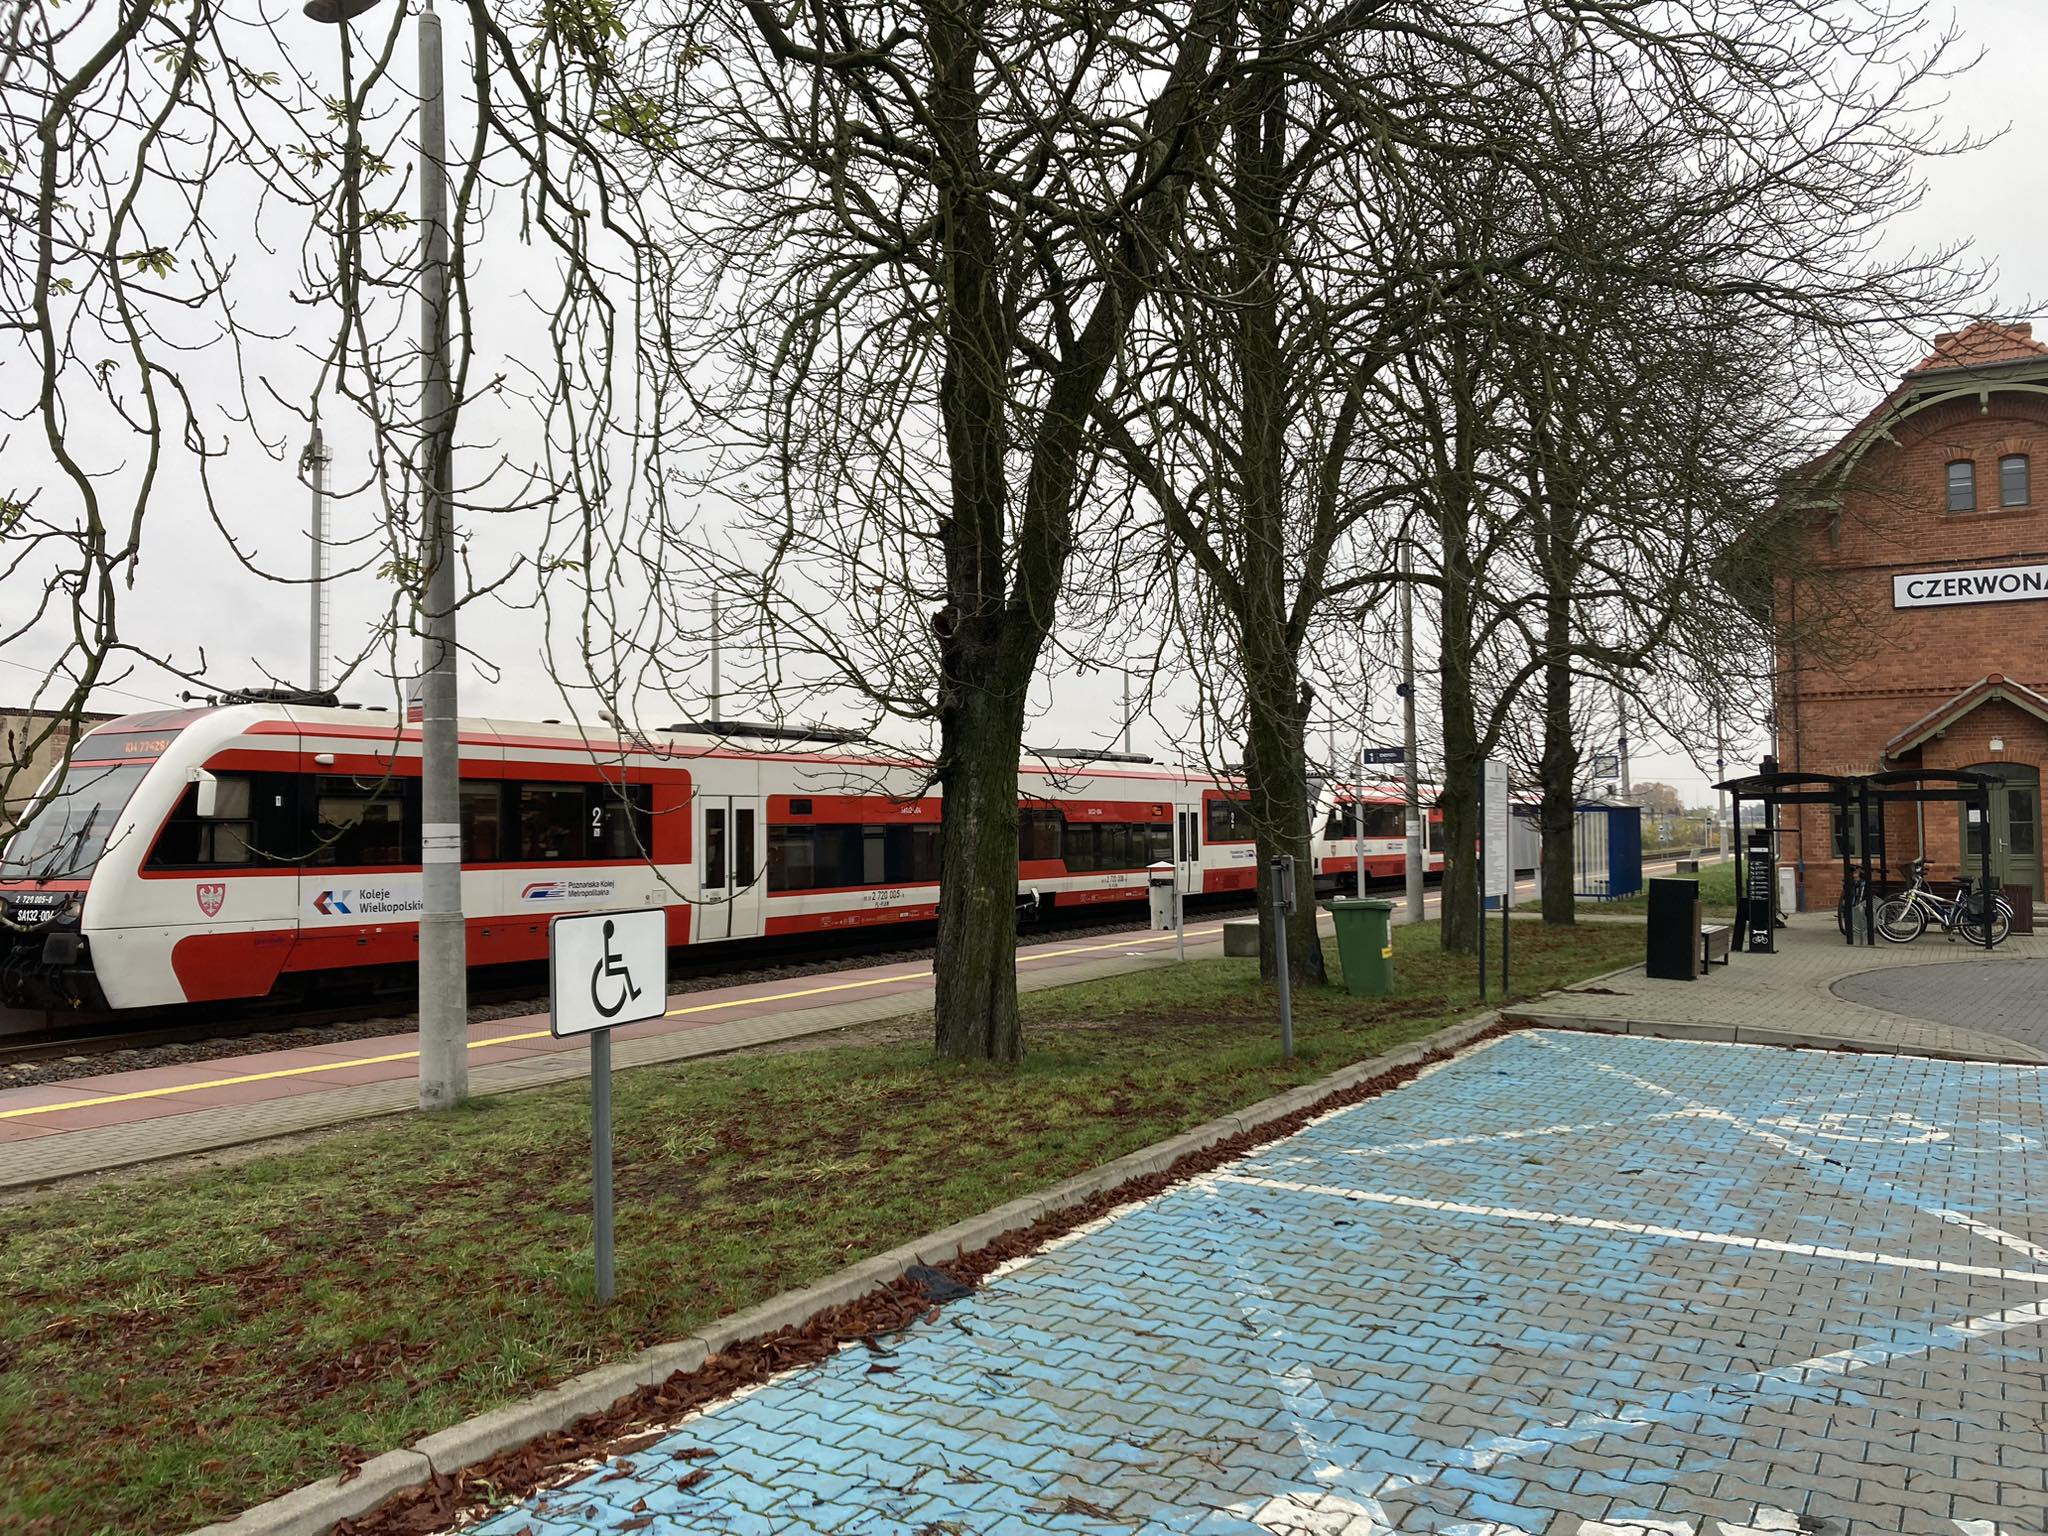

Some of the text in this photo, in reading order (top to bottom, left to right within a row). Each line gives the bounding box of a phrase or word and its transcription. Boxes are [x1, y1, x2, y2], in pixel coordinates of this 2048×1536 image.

[1907, 573, 2048, 599] CZERWON
[592, 807, 601, 826] 2
[601, 880, 614, 888] Kolej
[359, 889, 390, 900] Koleje
